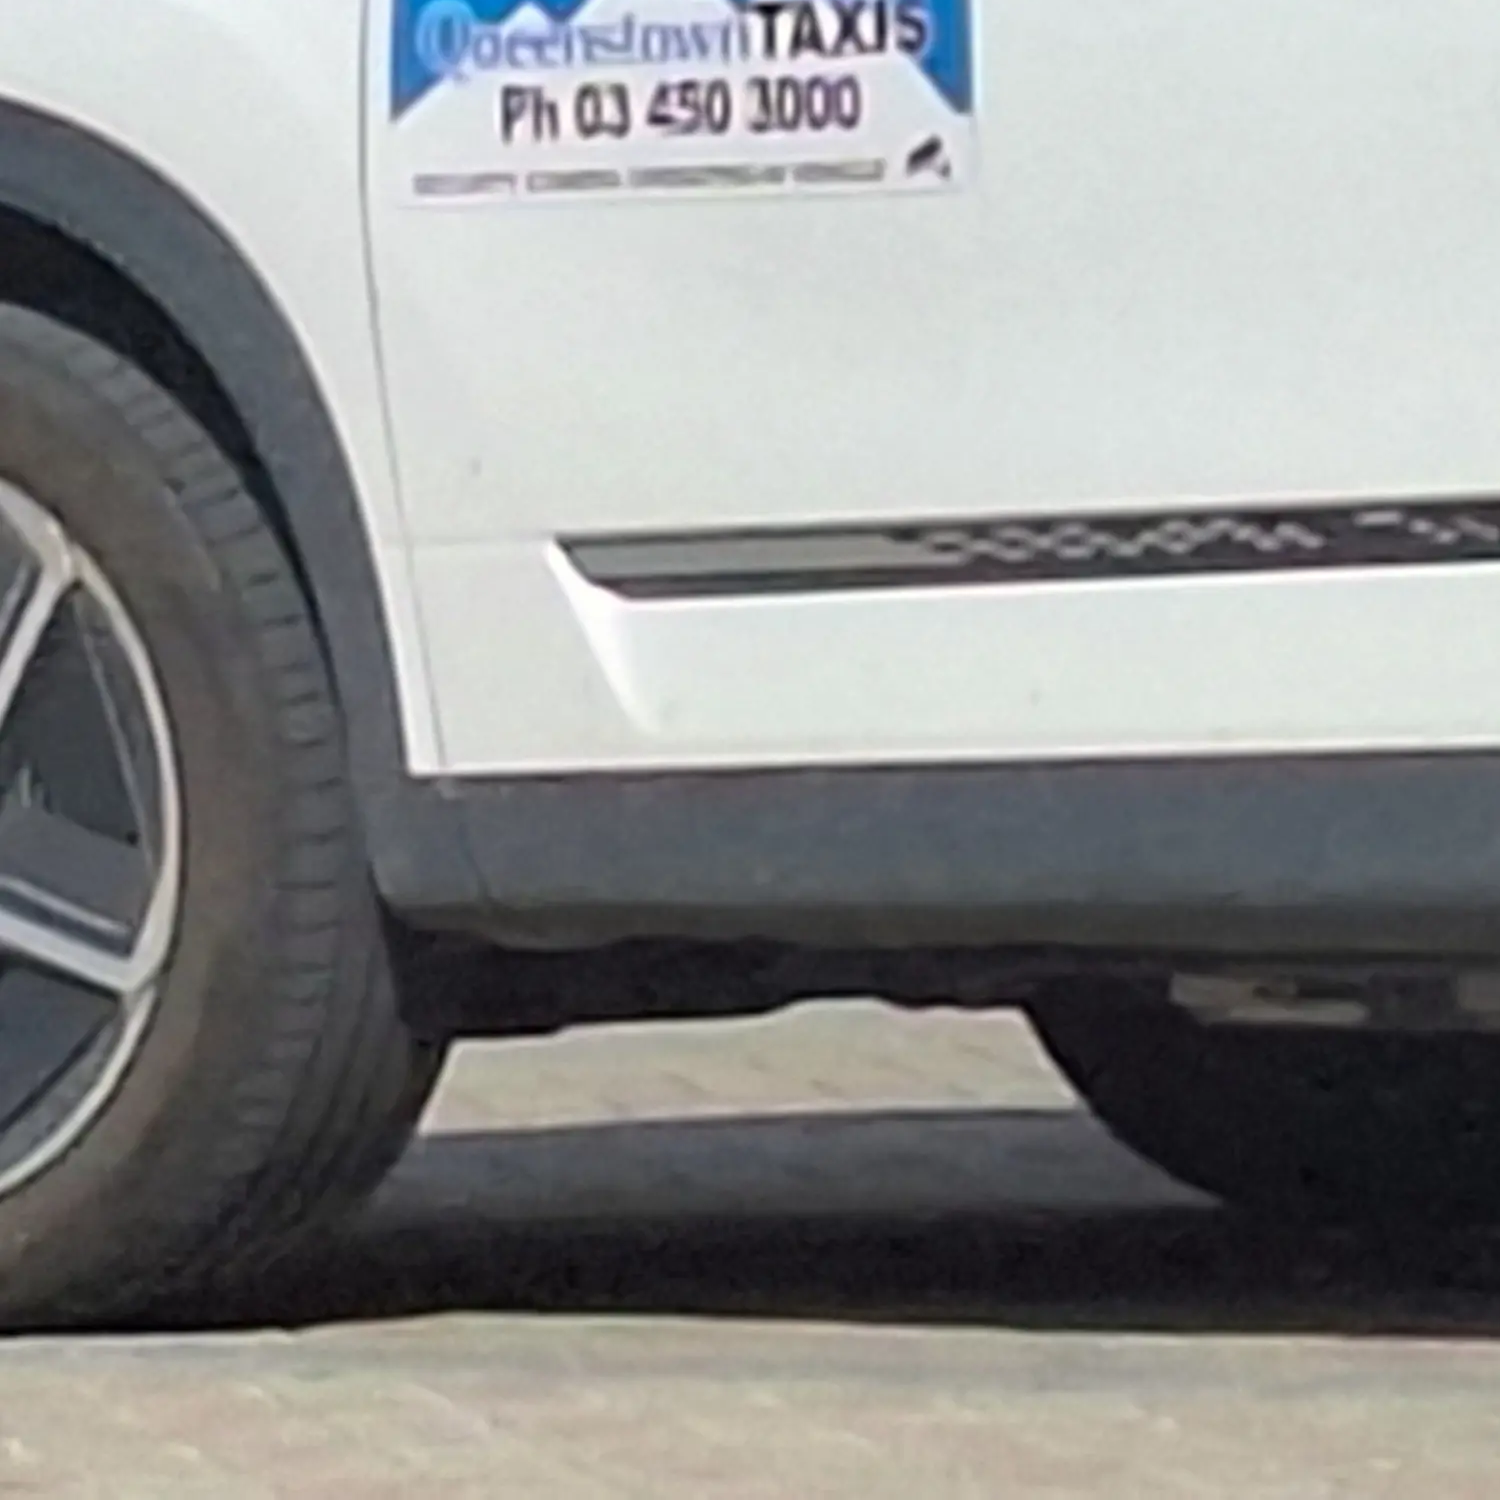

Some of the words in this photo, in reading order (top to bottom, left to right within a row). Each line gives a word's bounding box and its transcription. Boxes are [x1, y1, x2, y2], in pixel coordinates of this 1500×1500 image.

[501, 83, 559, 143] Ph
[574, 82, 630, 140] 03
[646, 78, 731, 137] 450
[746, 74, 862, 133] 3000
